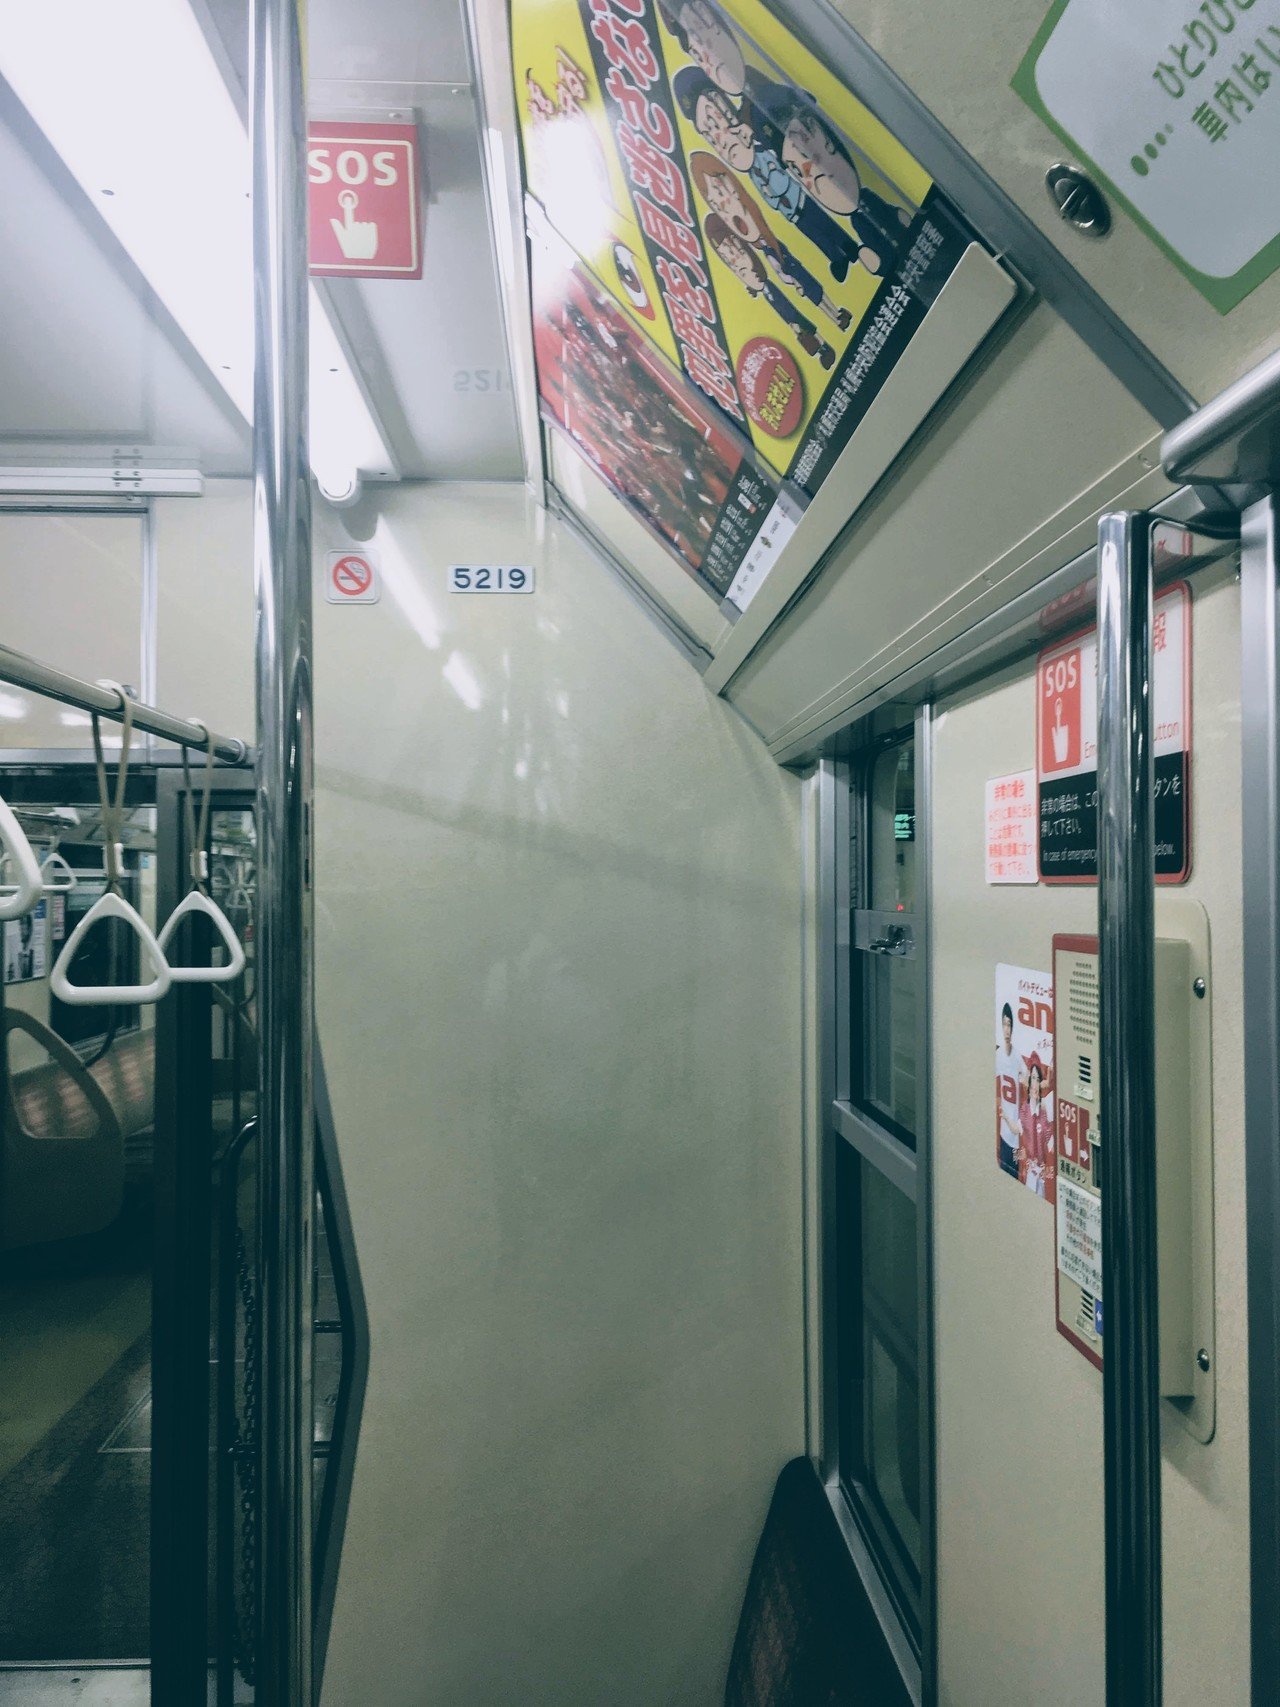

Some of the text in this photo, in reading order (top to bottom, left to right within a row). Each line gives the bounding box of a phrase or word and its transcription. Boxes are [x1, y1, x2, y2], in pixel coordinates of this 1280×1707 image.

[308, 149, 399, 187] SOS
[453, 567, 527, 590] 5219
[1044, 655, 1078, 698] SOS
[1018, 996, 1054, 1035] an
[1059, 1101, 1077, 1124] SOS
